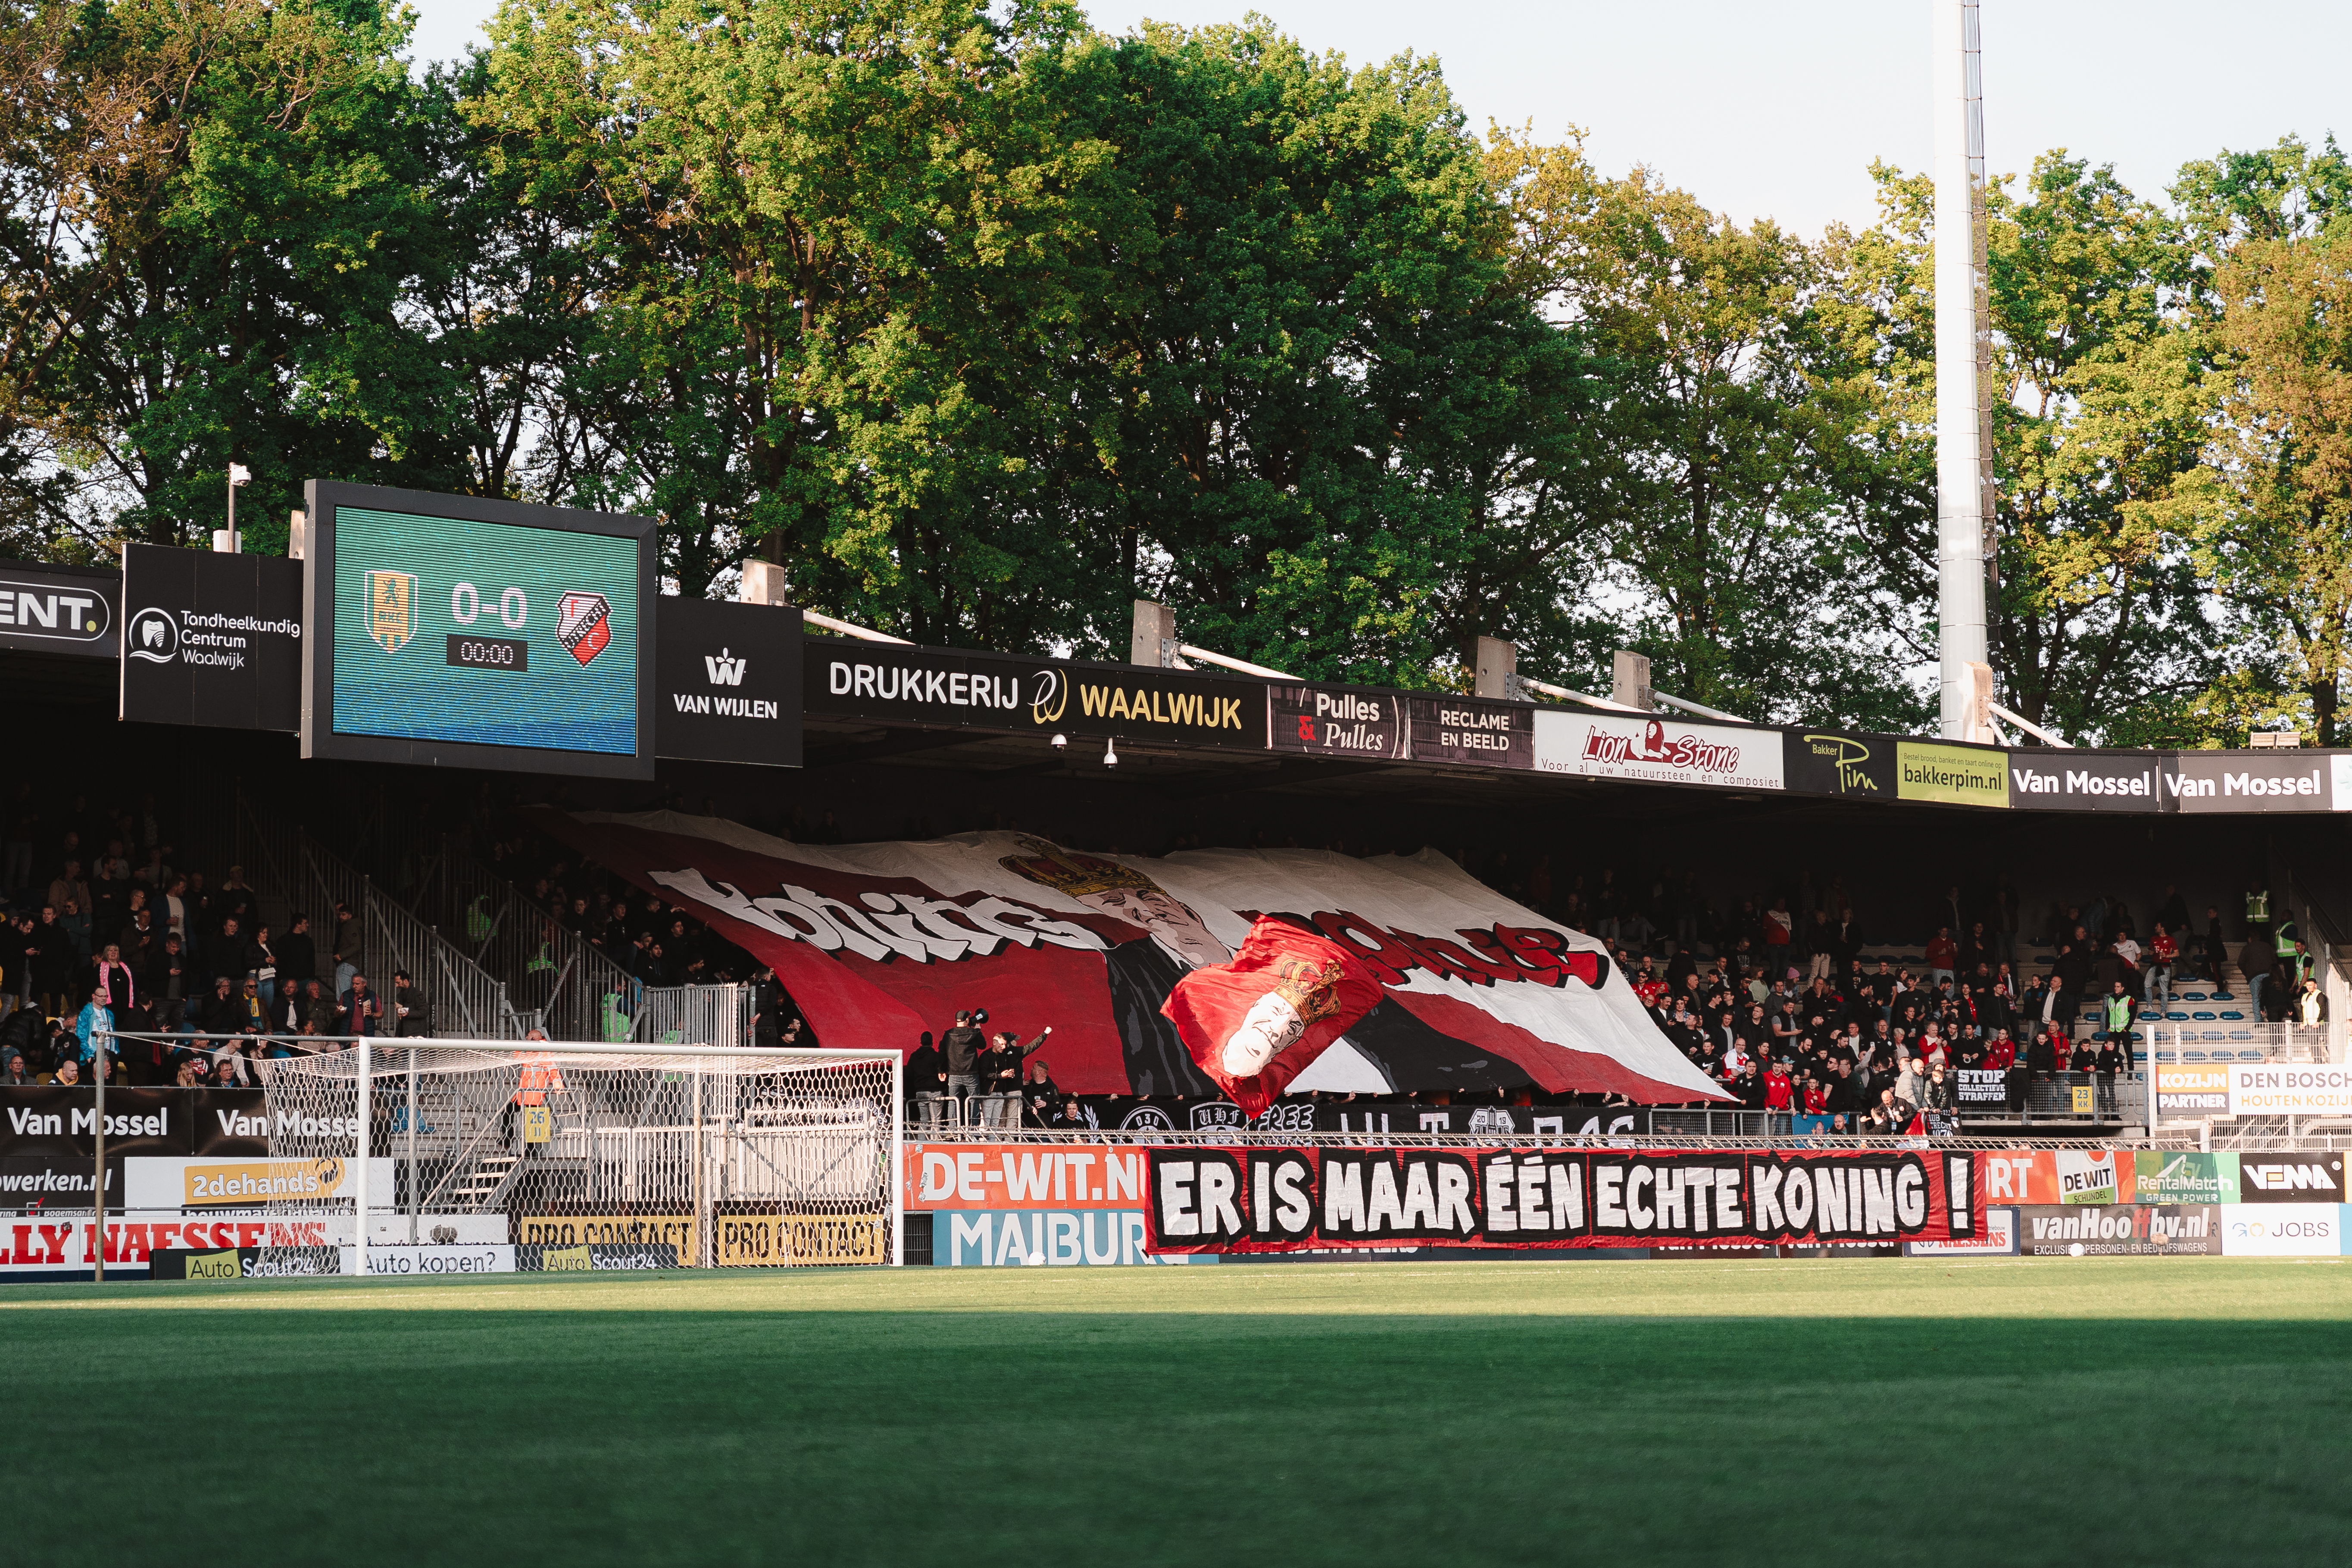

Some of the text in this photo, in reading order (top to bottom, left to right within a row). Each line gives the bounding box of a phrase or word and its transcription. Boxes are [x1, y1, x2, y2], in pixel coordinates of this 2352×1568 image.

[181, 611, 300, 637] Tandheelkundig
[181, 631, 246, 648] Centrum
[182, 649, 244, 670] Waalwijk
[461, 642, 513, 664] 00:00
[674, 694, 777, 719] VAN WIJLEN
[830, 662, 1241, 729] DRUKKERIJ WAALWIJK
[1317, 693, 1380, 722] Pulles
[1441, 710, 1509, 731] RECLAME
[1299, 716, 1383, 750] & Pulles
[1441, 732, 1509, 751] EN BEELD
[1583, 725, 1740, 773] Lion Stone
[1812, 744, 1837, 756] Bakker
[1921, 754, 1937, 763] brood,
[1939, 756, 1956, 765] banket
[1978, 760, 1994, 768] online
[1541, 758, 1779, 788] Voor al uw natuursteen en composiet
[1804, 735, 1877, 793] Pim
[1904, 763, 2002, 792] bakkerpim.nl
[2013, 769, 2150, 796] Van Mossel
[2165, 770, 2321, 797] Van Mossel
[1958, 1070, 2005, 1083] STOP
[2158, 1073, 2227, 1088] KOZIJN
[2241, 1073, 2279, 1088] DEN
[1959, 1092, 2005, 1101] STRAFFEN
[2077, 1090, 2088, 1099] 23
[2159, 1094, 2226, 1108] PARTNER
[2242, 1095, 2352, 1106] HOUTEN KOZIJ
[7, 1107, 167, 1136] Van Mossel
[217, 1110, 359, 1137] Van Mosse
[530, 1111, 544, 1124] 26
[1136, 1113, 1159, 1127] 030
[1258, 1104, 1315, 1132] FREE
[193, 1171, 318, 1197] 2dehands
[922, 1153, 1145, 1201] DE-WIT.N
[2064, 1168, 2111, 1192] DE WIT
[2138, 1174, 2233, 1191] RentalMatch
[2243, 1164, 2337, 1190] VEMA
[1160, 1156, 1969, 1236] ER IS MAAR ÉÉN ECHTE KONING !
[2074, 1191, 2107, 1203] SCHIJNDEL
[2183, 1193, 2218, 1202] POWER
[2033, 1208, 2210, 1240] vanHooffbv.nl
[2272, 1222, 2329, 1237] JOBS
[83, 1221, 326, 1263] NAESSENS
[725, 1221, 875, 1258] PRO CONTACT
[951, 1212, 1189, 1265] MAIBUR
[2085, 1243, 2129, 1254] PERSONEN-
[2131, 1244, 2141, 1253] EN
[419, 1252, 496, 1273] kopen?
